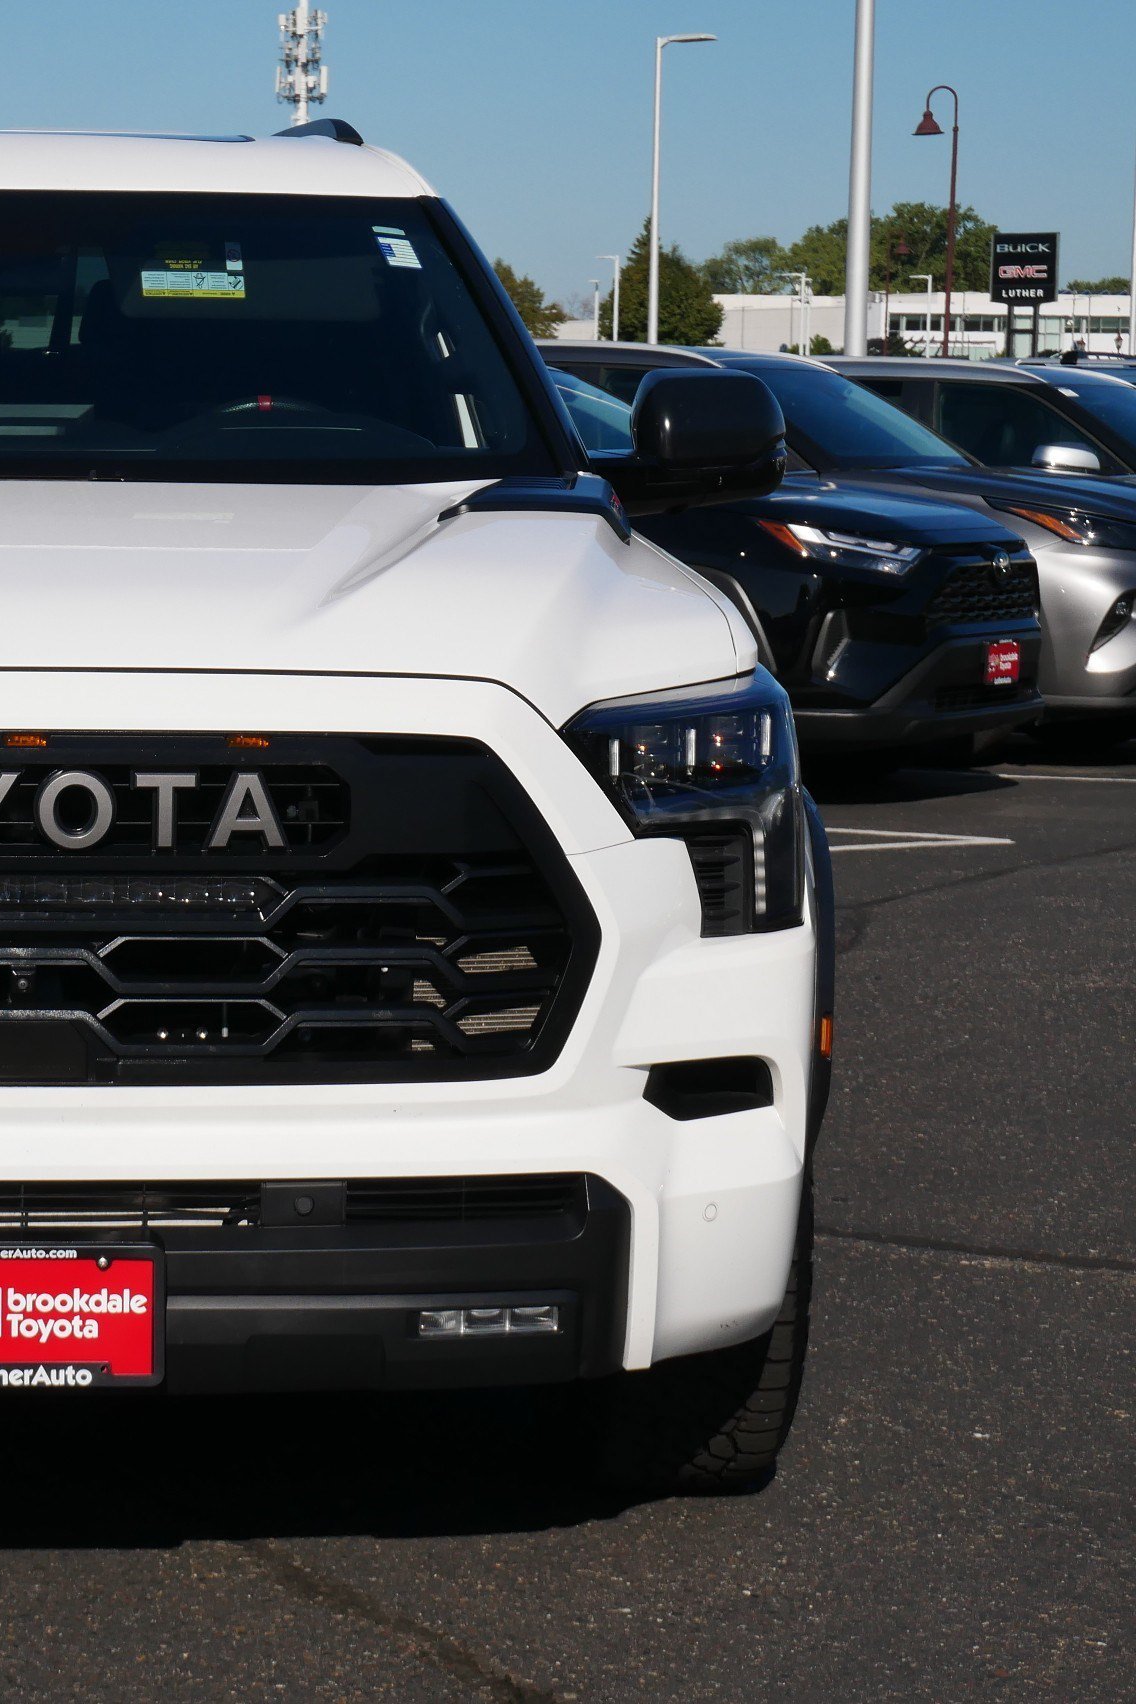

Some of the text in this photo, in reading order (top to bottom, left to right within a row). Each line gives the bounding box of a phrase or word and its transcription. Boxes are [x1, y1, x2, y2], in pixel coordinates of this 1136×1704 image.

[996, 242, 1051, 253] BUICK
[998, 264, 1048, 279] GMC
[1002, 289, 1044, 298] LUTHER
[6, 1287, 148, 1314] brookdale
[5, 1313, 99, 1343] Toyota
